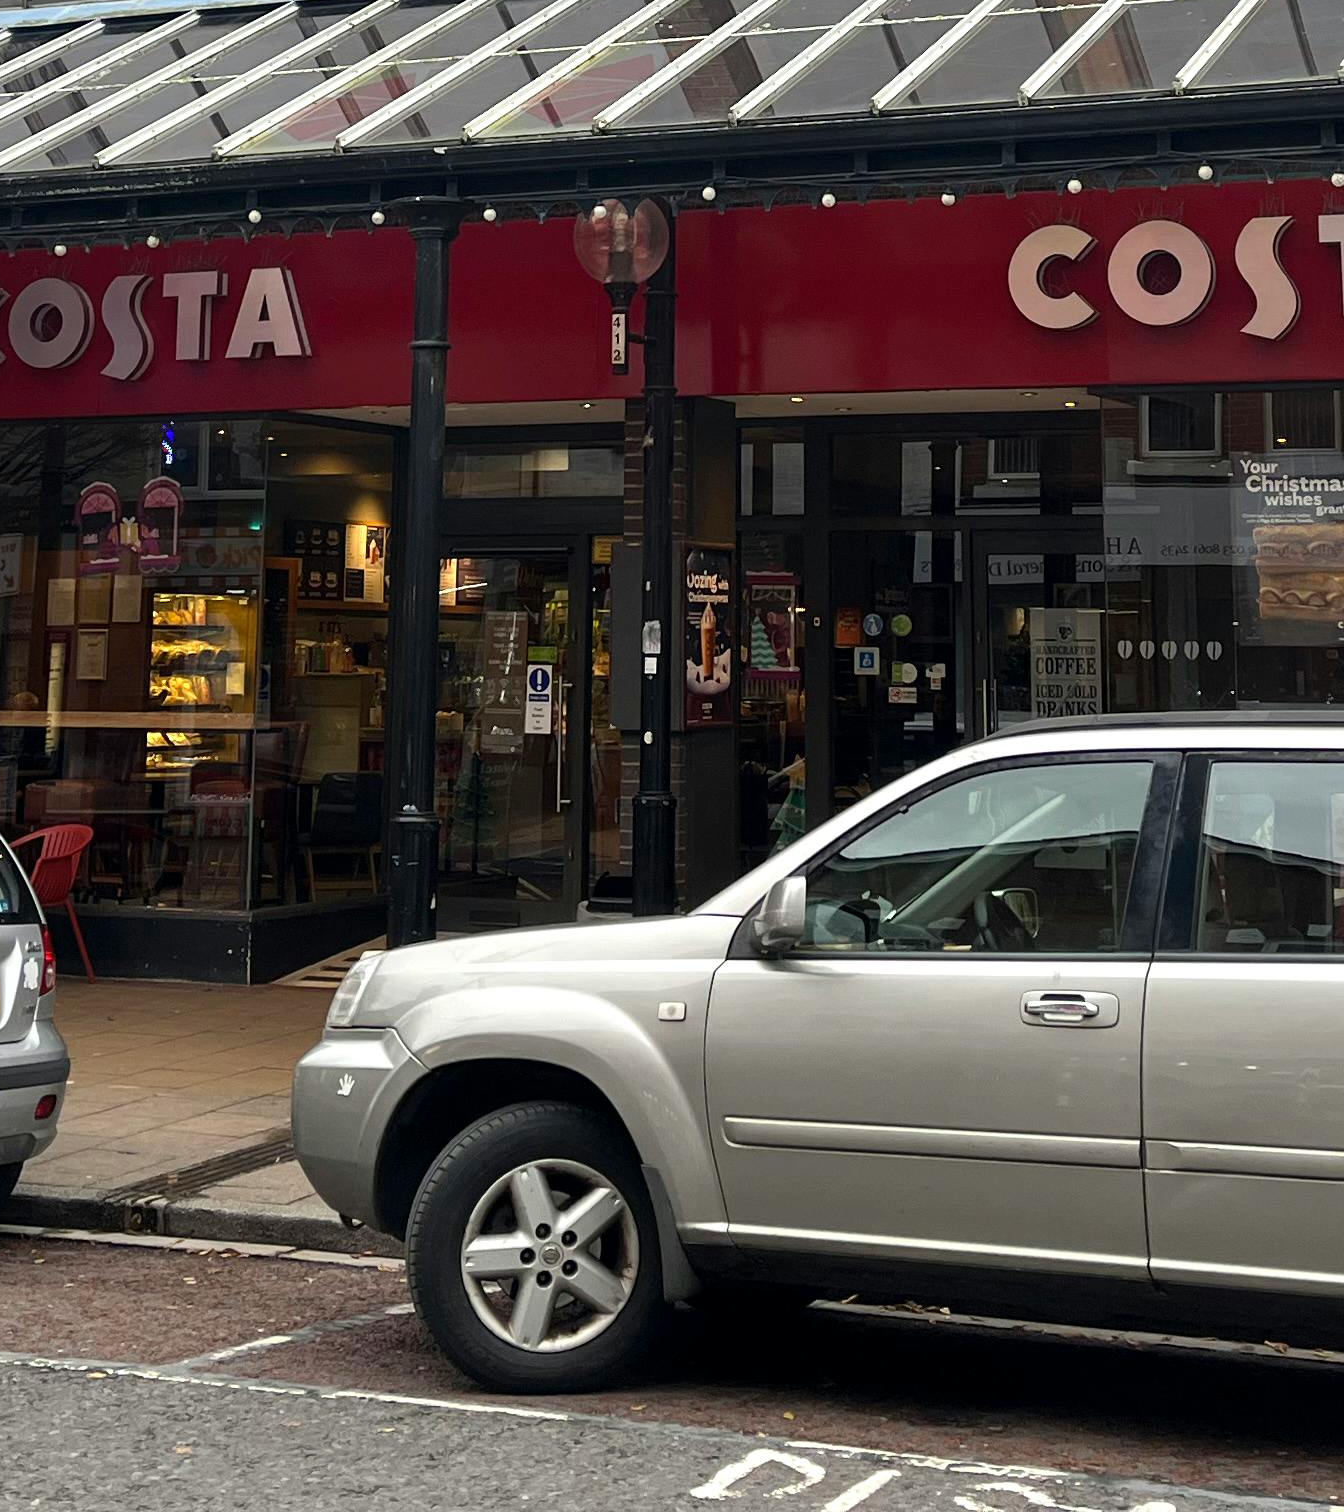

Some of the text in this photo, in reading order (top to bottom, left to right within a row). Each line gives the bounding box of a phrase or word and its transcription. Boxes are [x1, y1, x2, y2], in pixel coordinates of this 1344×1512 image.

[1240, 459, 1278, 474] Your
[1264, 492, 1323, 506] wishes
[1036, 657, 1096, 675] COFFEE
[1036, 684, 1064, 698] ICED
